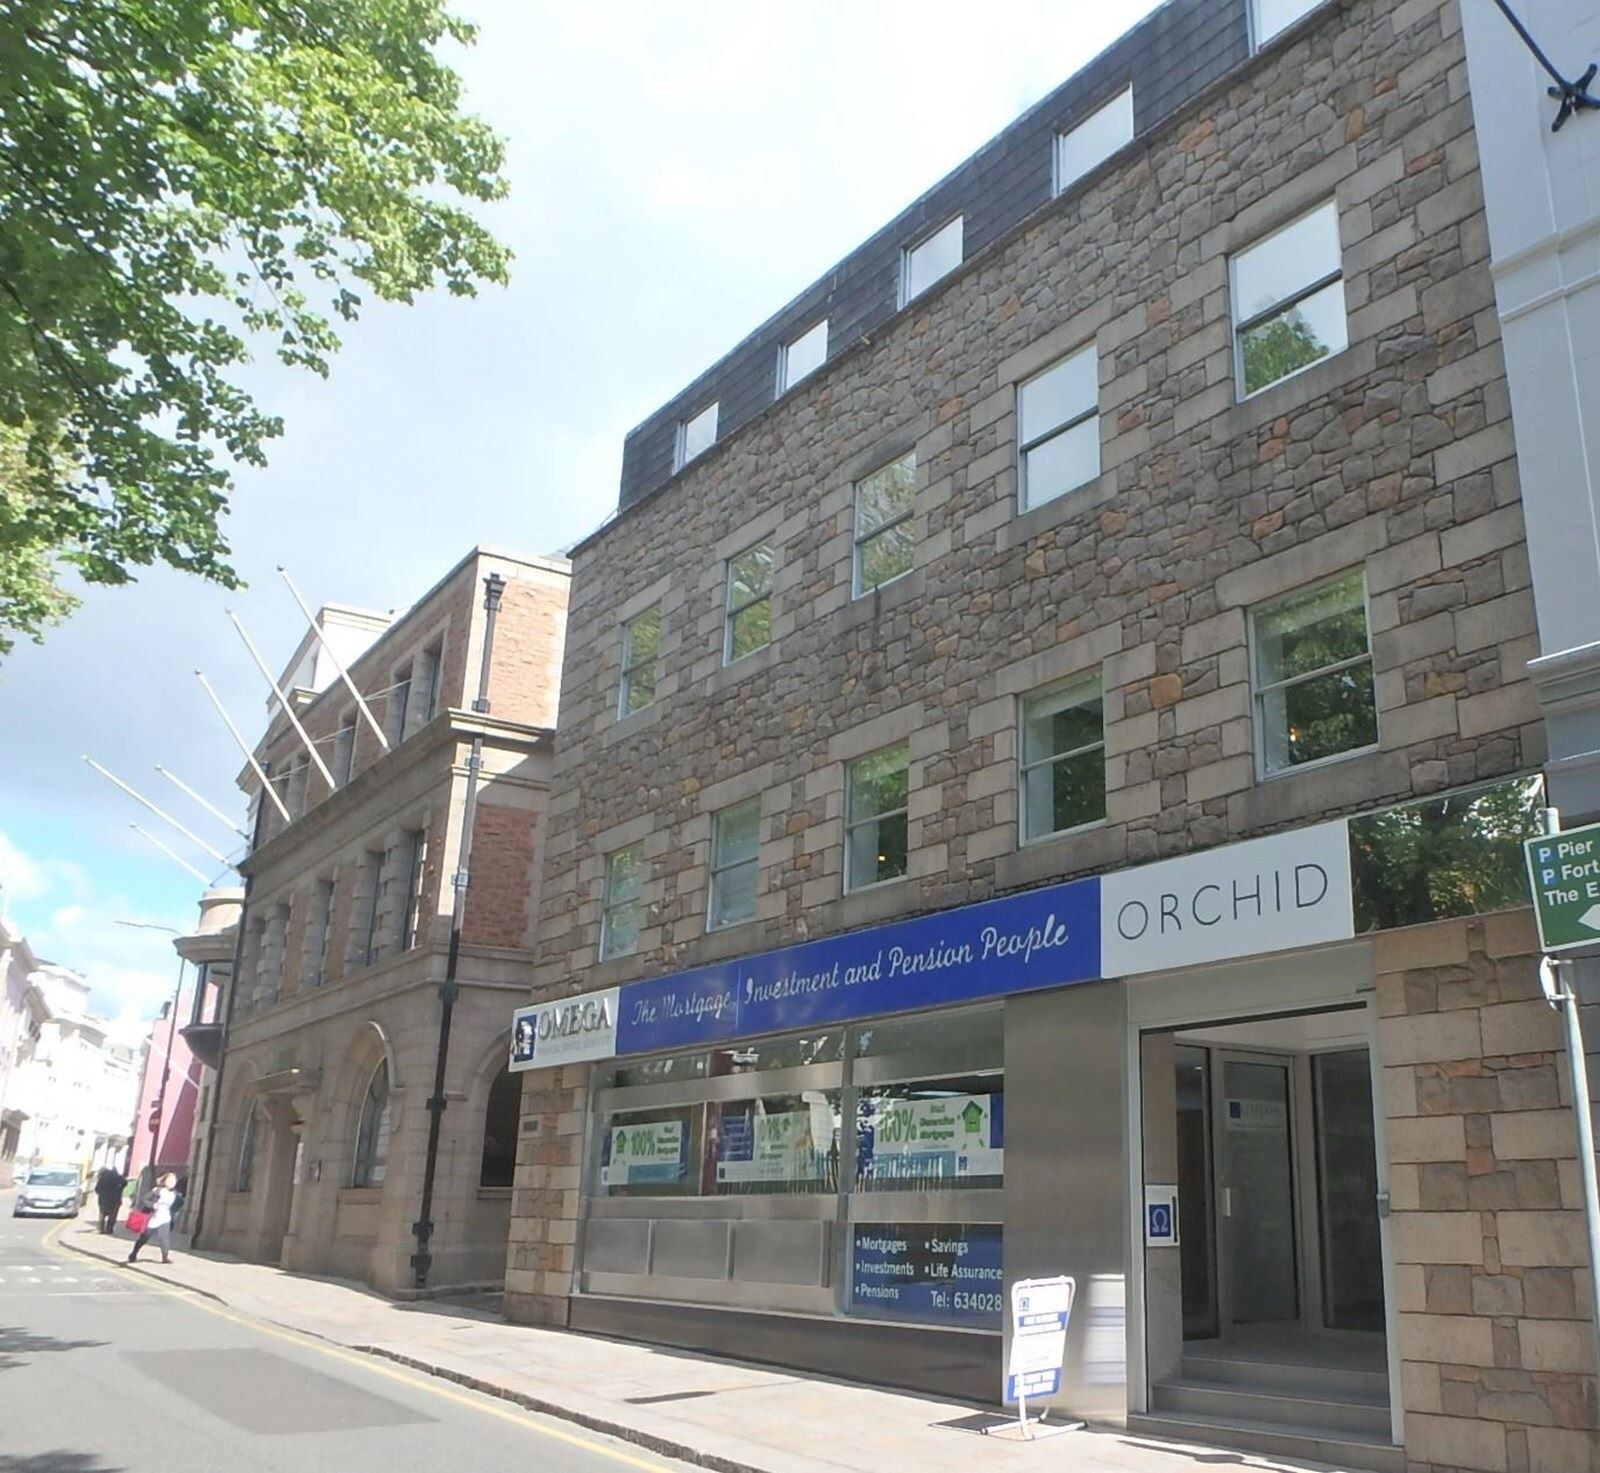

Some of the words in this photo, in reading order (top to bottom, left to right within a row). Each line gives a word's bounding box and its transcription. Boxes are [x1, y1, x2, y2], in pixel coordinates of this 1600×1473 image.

[1557, 840, 1594, 859] Pier
[1561, 859, 1600, 881] Fort
[1117, 863, 1328, 940] ORCHID
[1544, 889, 1579, 906] The
[631, 999, 657, 1026] The
[744, 961, 839, 1005] Investment
[844, 951, 882, 982] and
[888, 939, 974, 979] Pension
[980, 914, 1069, 963] People
[537, 997, 612, 1040] OMEGA
[862, 1237, 907, 1253] Mortgages
[931, 1238, 968, 1256] Savings
[861, 1261, 914, 1276] Investments
[931, 1263, 949, 1277] Life
[951, 1263, 1003, 1280] Assurance
[860, 1283, 899, 1299] Pensions
[931, 1290, 950, 1308] Tel:
[953, 1292, 1002, 1312] 634028
